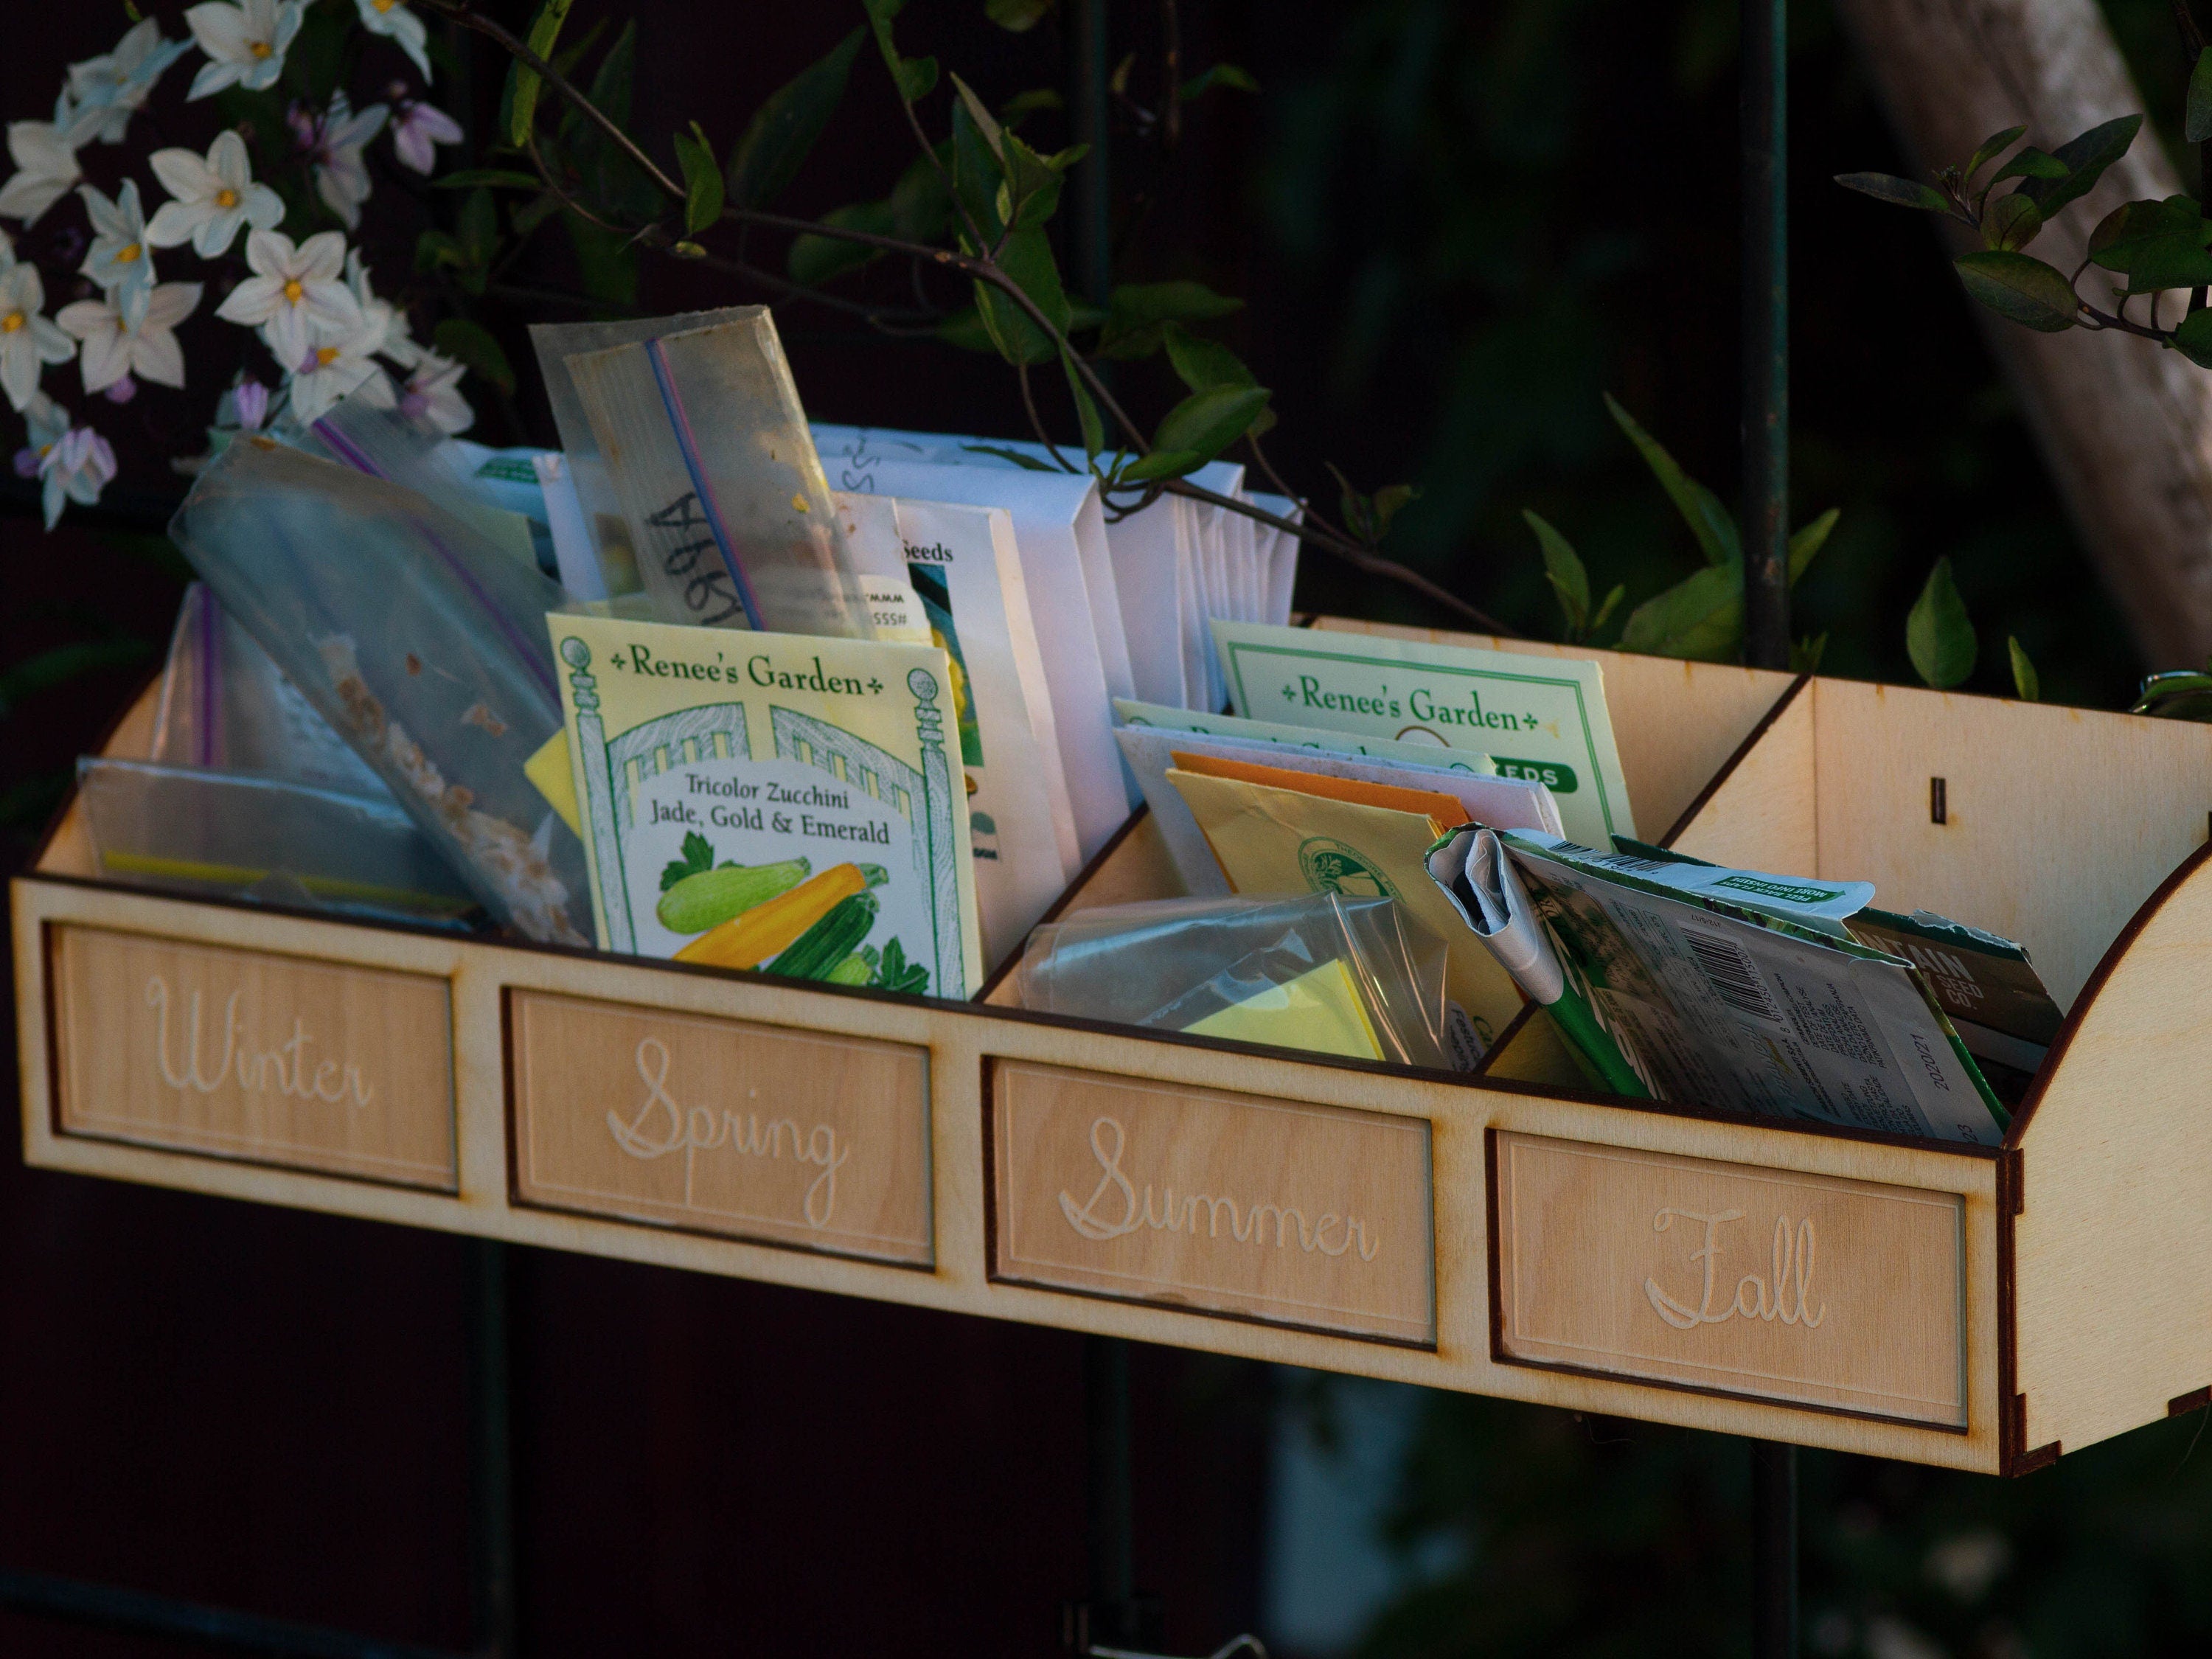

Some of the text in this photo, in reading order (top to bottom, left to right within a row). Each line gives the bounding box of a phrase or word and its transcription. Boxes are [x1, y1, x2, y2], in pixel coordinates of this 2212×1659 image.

[628, 644, 863, 695] Renee's Garden
[1298, 676, 1518, 732] Renee's Garden
[686, 773, 849, 810] Tricolor Zucchini
[1495, 764, 1558, 785] EDS
[649, 799, 889, 845] Jade, Gold & Emerald
[1720, 881, 1812, 902] PEEL BACK FLAPS
[1730, 877, 1828, 898] MORE INFO INSIDE
[1935, 975, 1984, 998] SEED
[1945, 989, 1978, 1010] CO.
[147, 975, 373, 1107] Winter
[1910, 1033, 1950, 1091] 2020/21
[606, 1037, 849, 1229] Spring
[1958, 1124, 1978, 1144] 23
[1059, 1116, 1379, 1262] Summer
[1644, 1206, 1826, 1329] Fall
